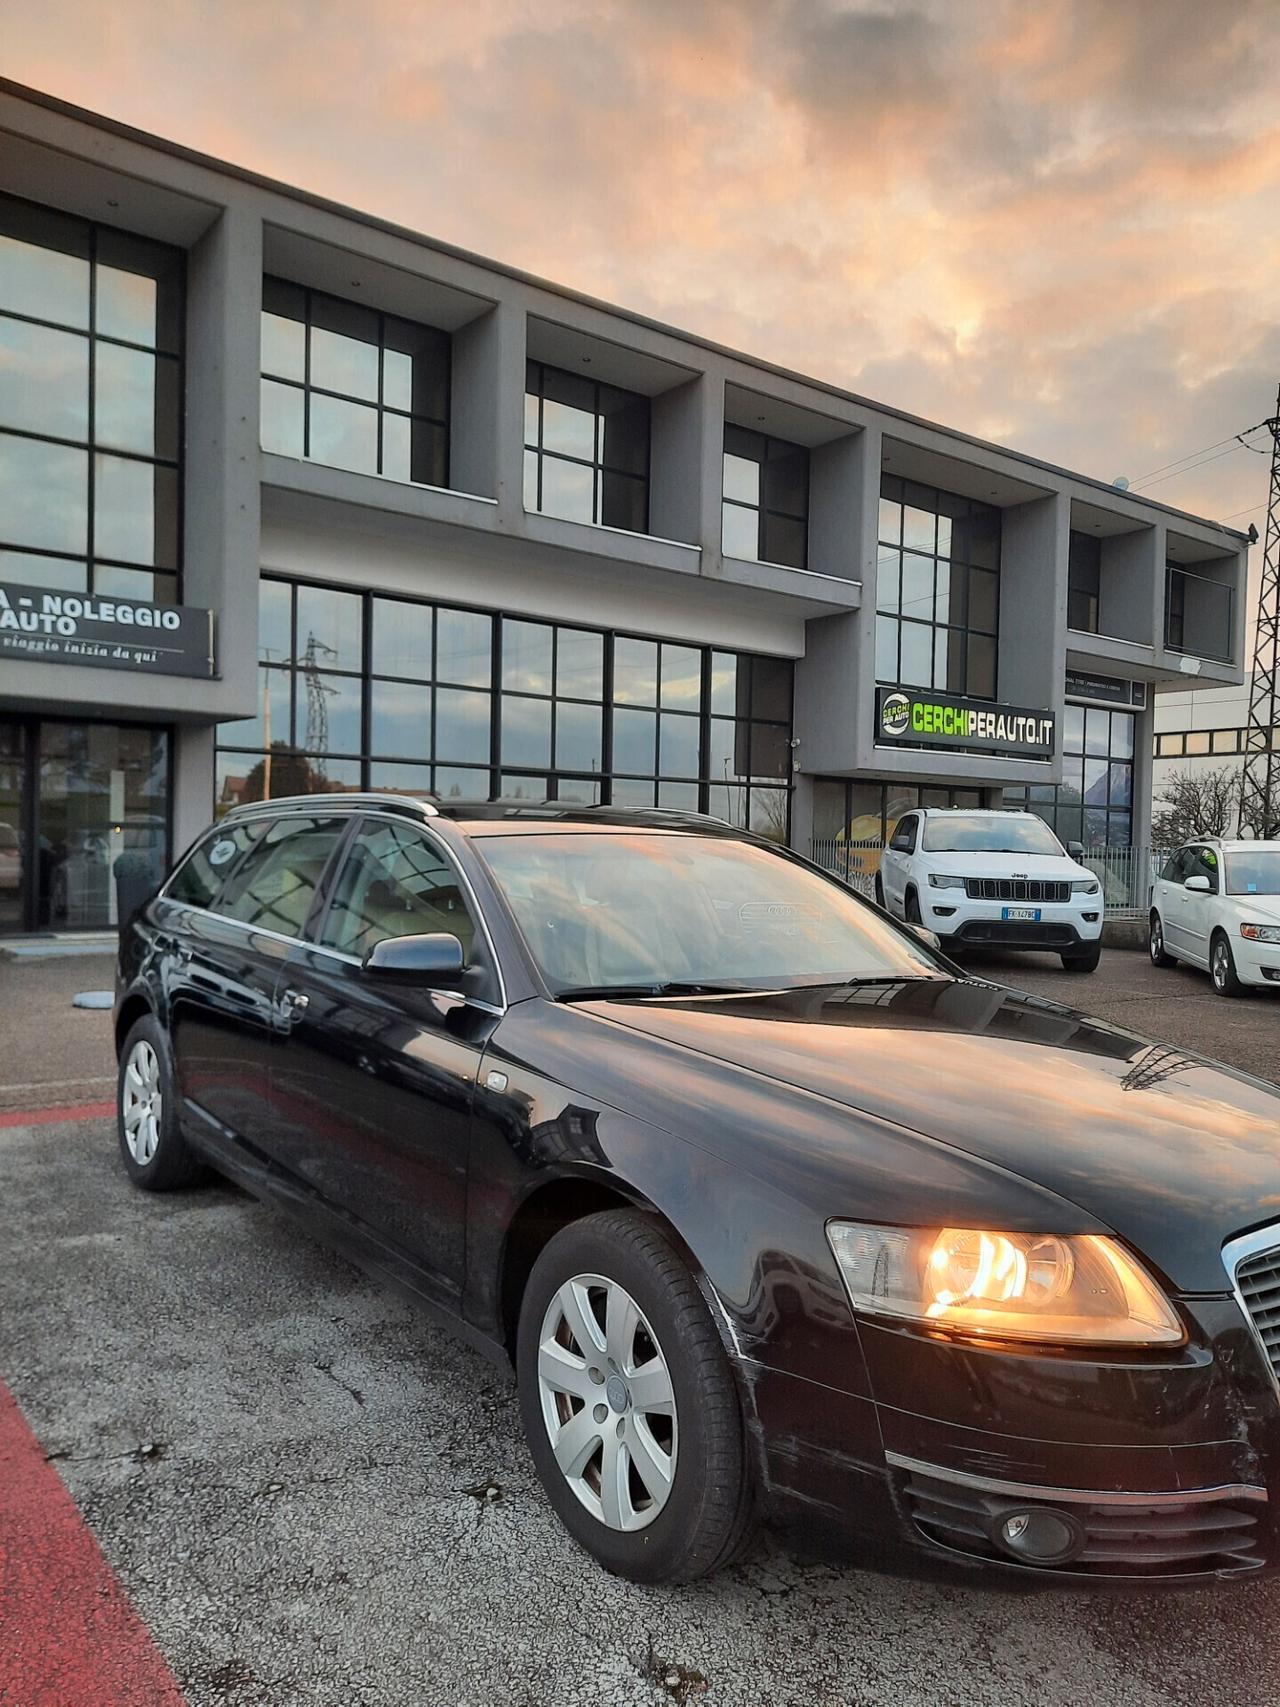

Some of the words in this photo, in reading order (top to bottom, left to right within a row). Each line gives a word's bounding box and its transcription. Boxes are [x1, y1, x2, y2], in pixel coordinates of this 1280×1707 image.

[0, 609, 77, 636] AUTO
[43, 594, 181, 630] NOLEGGIO
[63, 640, 108, 657] inizia
[112, 646, 130, 659] da
[883, 703, 910, 718] CERCHI
[894, 711, 910, 721] AUTO
[912, 702, 1053, 745] CERCHIPERAUTO.IT
